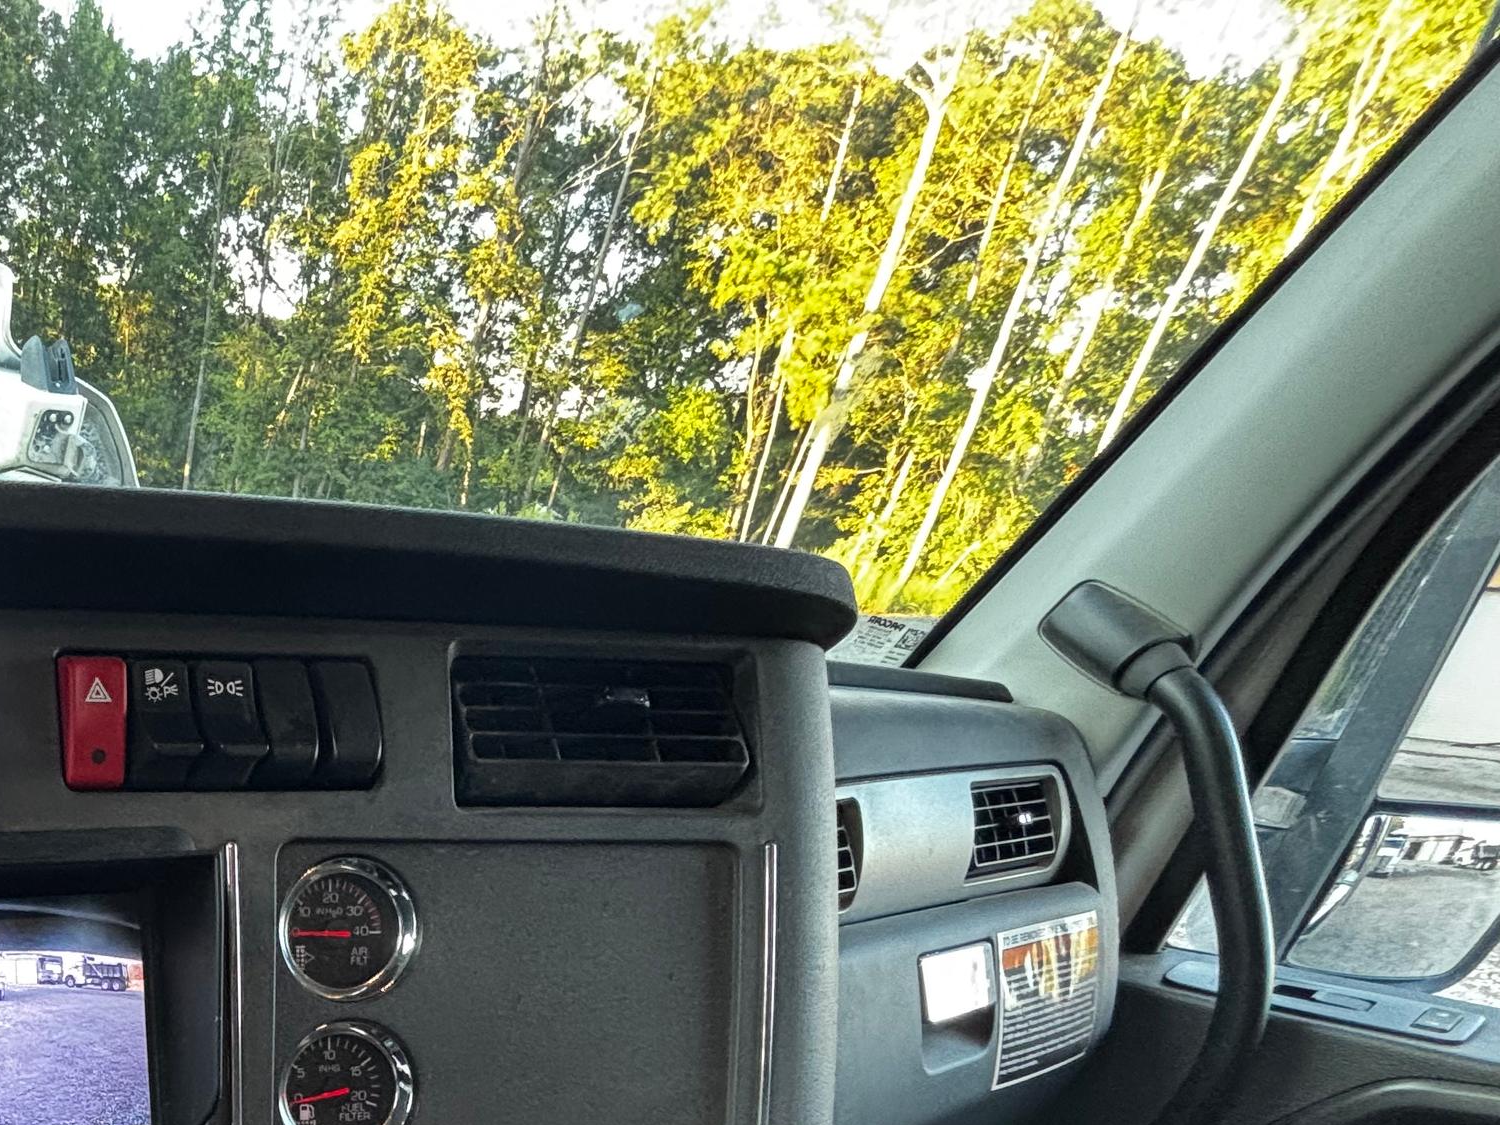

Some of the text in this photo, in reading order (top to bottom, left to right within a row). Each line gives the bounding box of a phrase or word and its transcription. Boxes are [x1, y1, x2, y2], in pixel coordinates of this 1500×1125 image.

[345, 905, 364, 917] 30
[350, 946, 369, 956] AIR
[322, 1049, 336, 1060] 10
[297, 1068, 306, 1078] 5
[349, 1066, 362, 1077] 15
[351, 1090, 367, 1101] 20
[339, 1112, 371, 1122] FILTER
